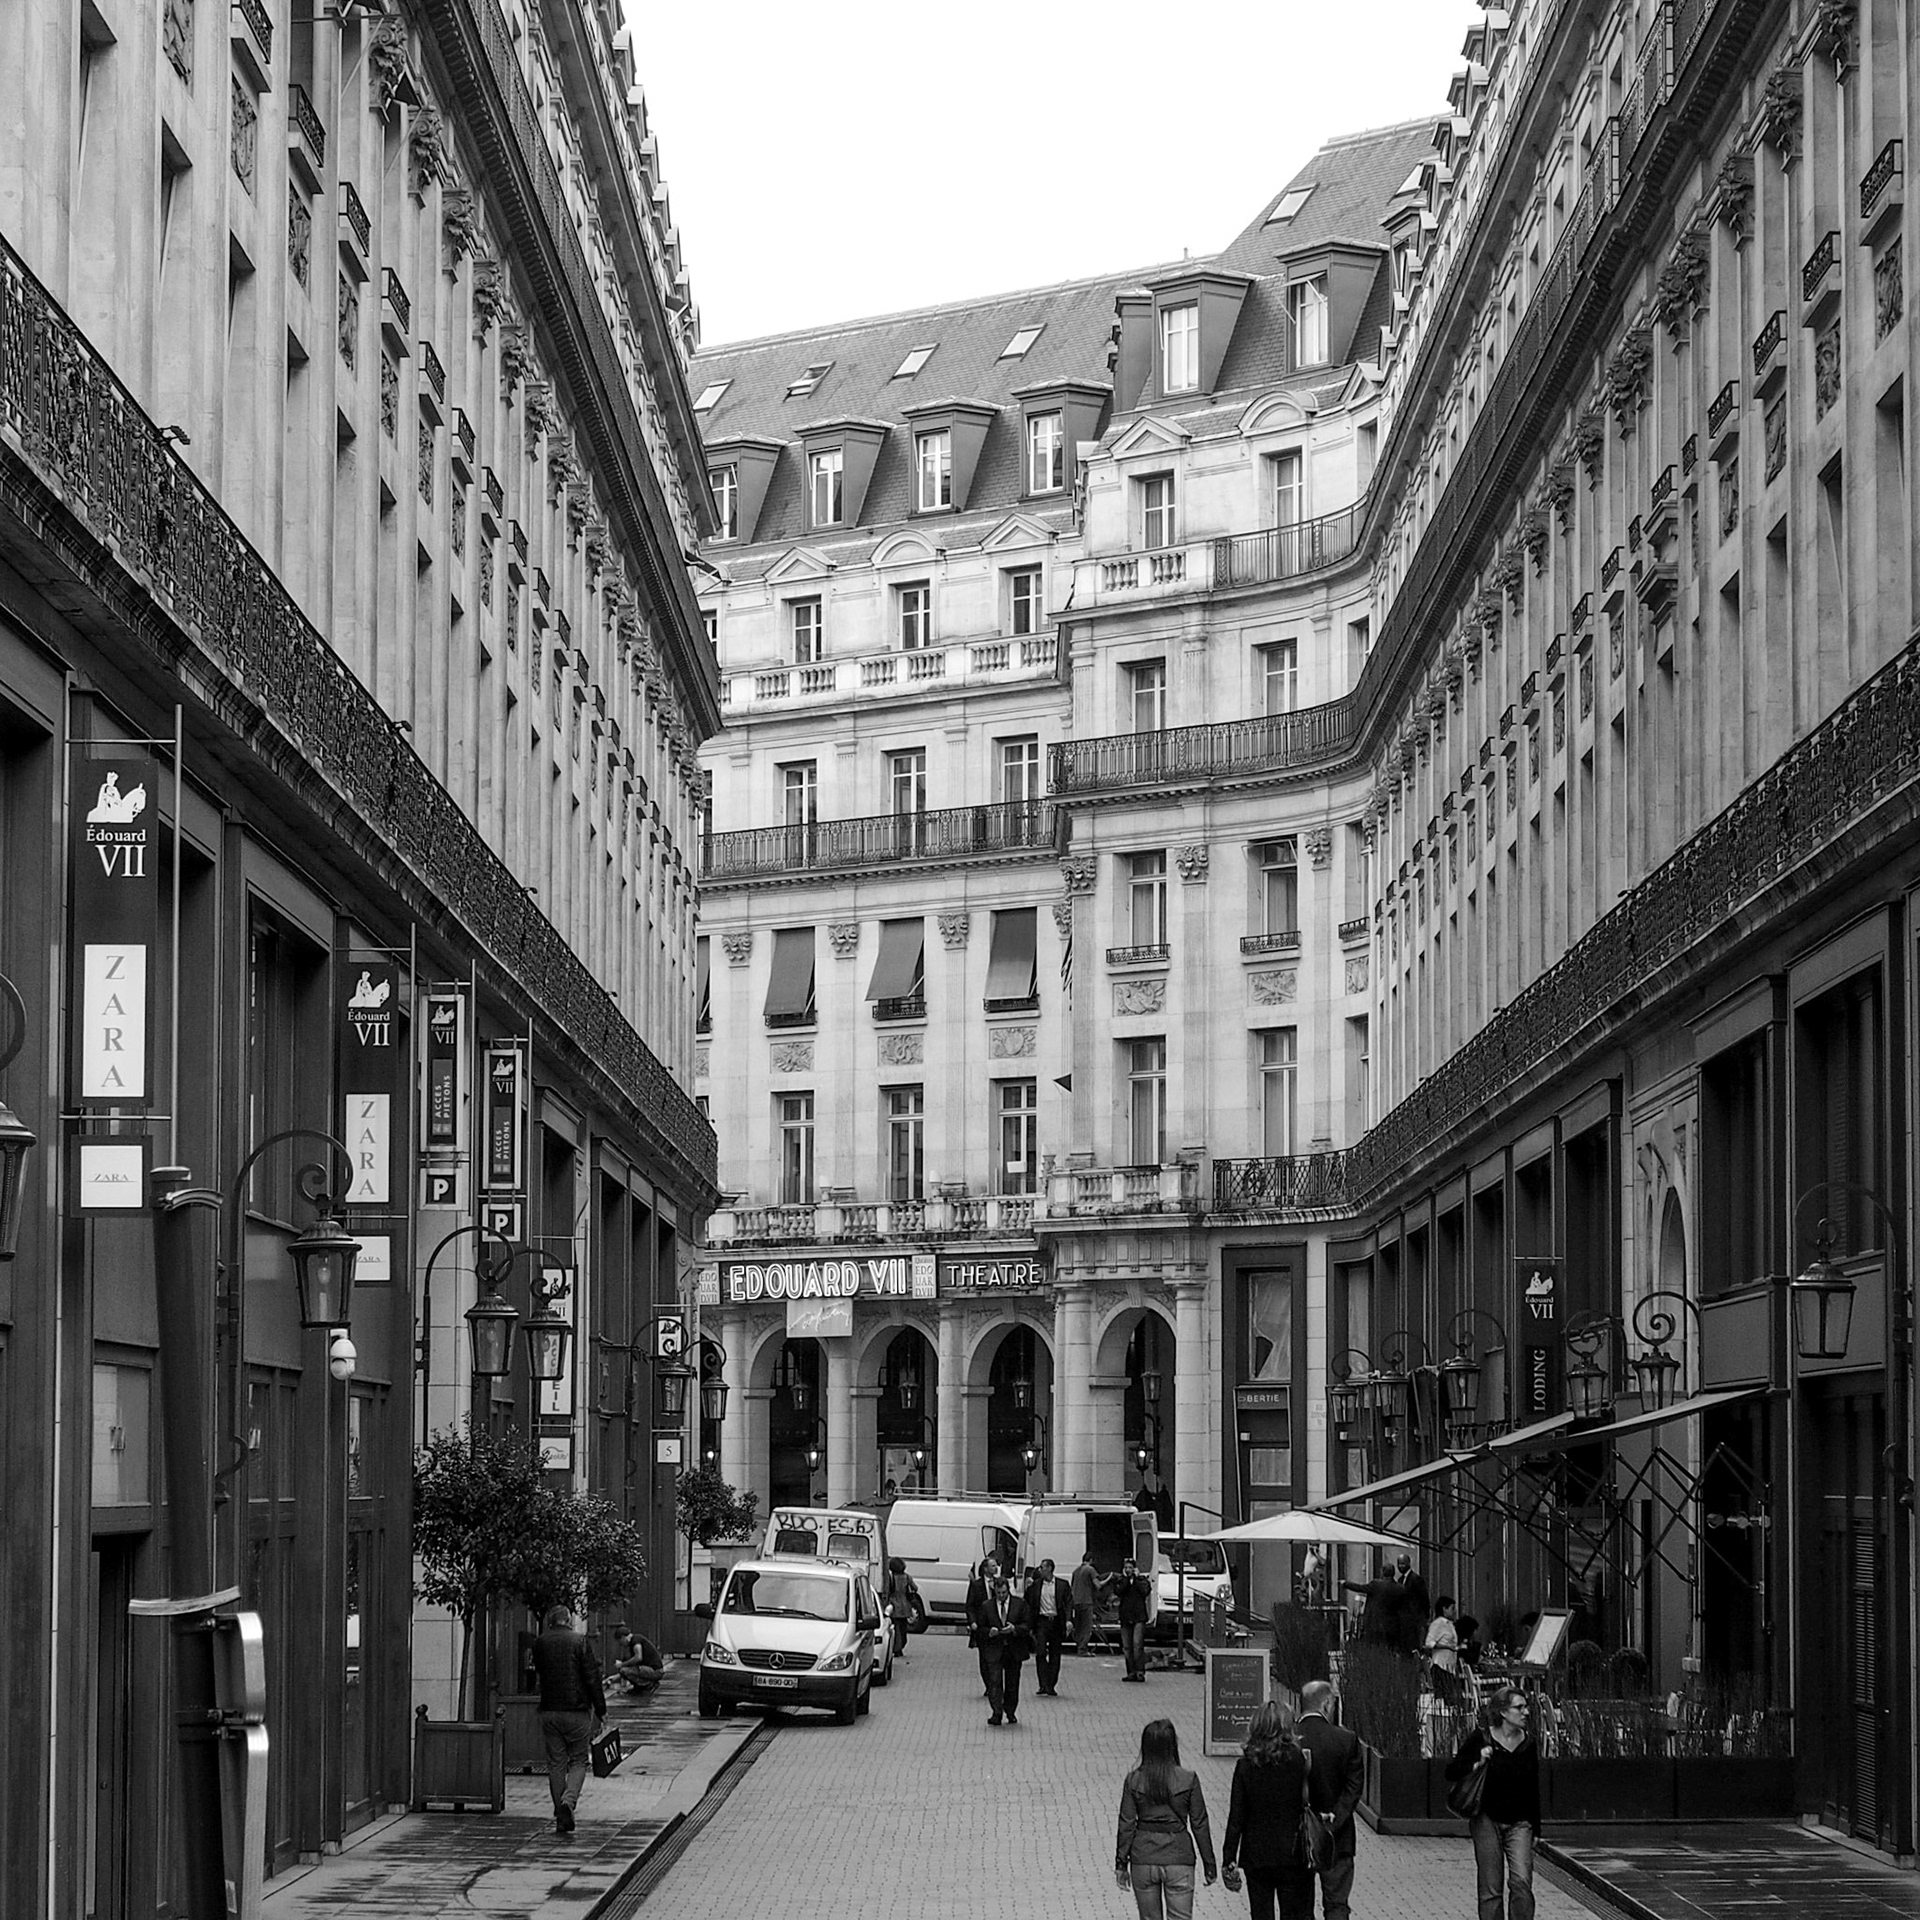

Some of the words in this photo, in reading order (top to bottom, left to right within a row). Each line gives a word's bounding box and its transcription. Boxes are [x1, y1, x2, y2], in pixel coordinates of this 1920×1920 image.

[86, 824, 146, 842] Édouard
[95, 844, 147, 877] VII
[101, 955, 126, 1087] ZARA
[348, 1008, 391, 1021] Édouard
[354, 1022, 391, 1046] VII
[435, 1031, 454, 1044] VII
[443, 1075, 451, 1118] PIETONS
[496, 1081, 513, 1093] VII
[359, 1100, 376, 1195] ZARA
[94, 1173, 129, 1181] ZARA
[433, 1178, 449, 1201] P
[494, 1213, 509, 1233] P
[730, 1261, 860, 1300] EDOUARD
[868, 1258, 906, 1294] VII
[946, 1263, 1041, 1286] THEATRE
[1530, 1303, 1554, 1319] VII
[1534, 1349, 1546, 1411] LODING
[665, 1445, 672, 1457] 5
